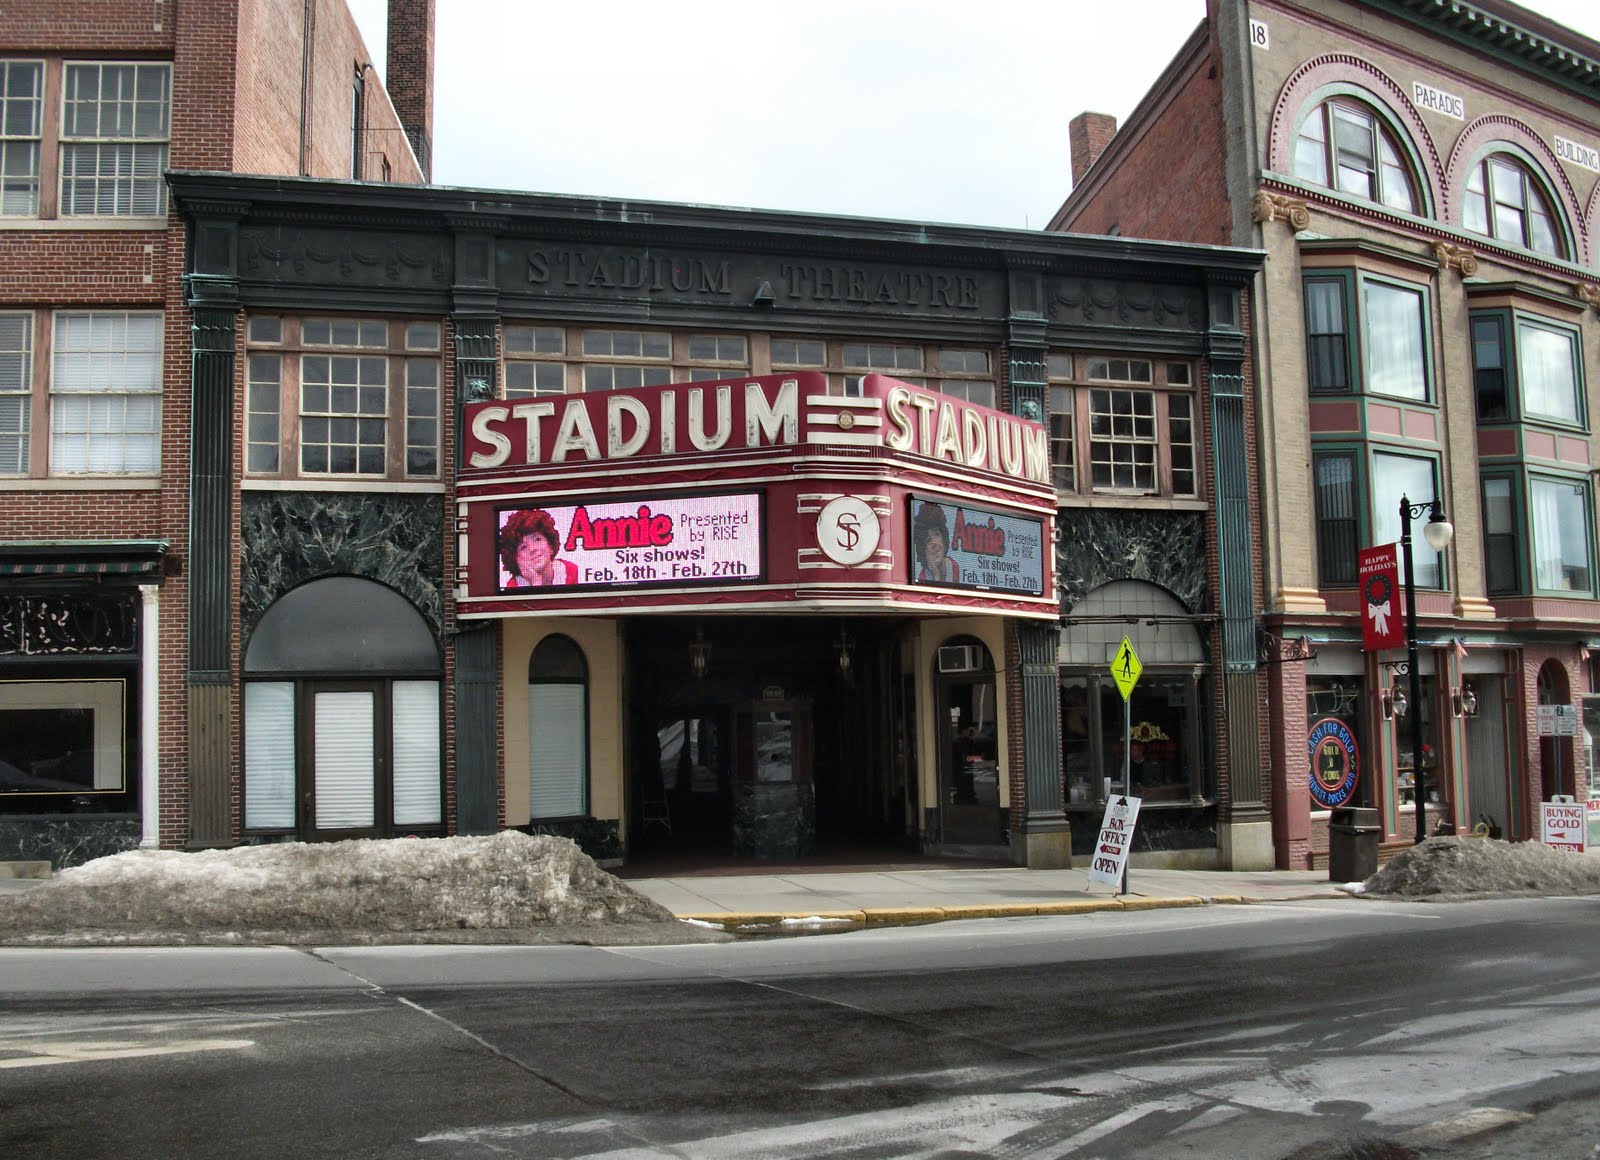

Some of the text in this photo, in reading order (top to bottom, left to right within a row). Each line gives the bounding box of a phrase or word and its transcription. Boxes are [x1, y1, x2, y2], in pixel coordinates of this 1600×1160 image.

[1252, 23, 1266, 45] 18
[1415, 84, 1463, 118] PARADIS
[527, 248, 980, 310] STADIUM THEATRE
[469, 379, 798, 469] STADIUM
[886, 386, 1050, 483] STADIUM
[680, 509, 748, 527] Presented
[564, 505, 674, 551] Annie
[689, 525, 739, 541] by RISE
[952, 508, 1006, 557] Annie
[1007, 530, 1038, 546] Presented
[615, 545, 705, 564] Six shows!
[1012, 546, 1034, 559] by RISE
[1365, 554, 1389, 565] HAPPY
[585, 567, 618, 582] Feb.
[622, 565, 656, 580] 18th
[672, 562, 707, 578] Feb.
[712, 560, 747, 576] 27th
[977, 556, 1020, 573] Six shows!
[1359, 562, 1397, 574] HOLIDAYS
[962, 569, 980, 584] Feb.
[982, 572, 999, 586] 18th
[1004, 573, 1020, 588] Feb.
[1022, 576, 1038, 589] 27th
[1308, 723, 1355, 755] CASH FOR GOLD
[1323, 745, 1339, 756] GOLD
[1327, 788, 1347, 804] PRICES
[1345, 771, 1356, 790] PAID
[1546, 808, 1581, 818] BUYING
[1109, 818, 1125, 831] BOX
[1547, 818, 1580, 829] GOLD
[1100, 830, 1128, 846] OFFICE
[1093, 857, 1120, 875] OPEN
